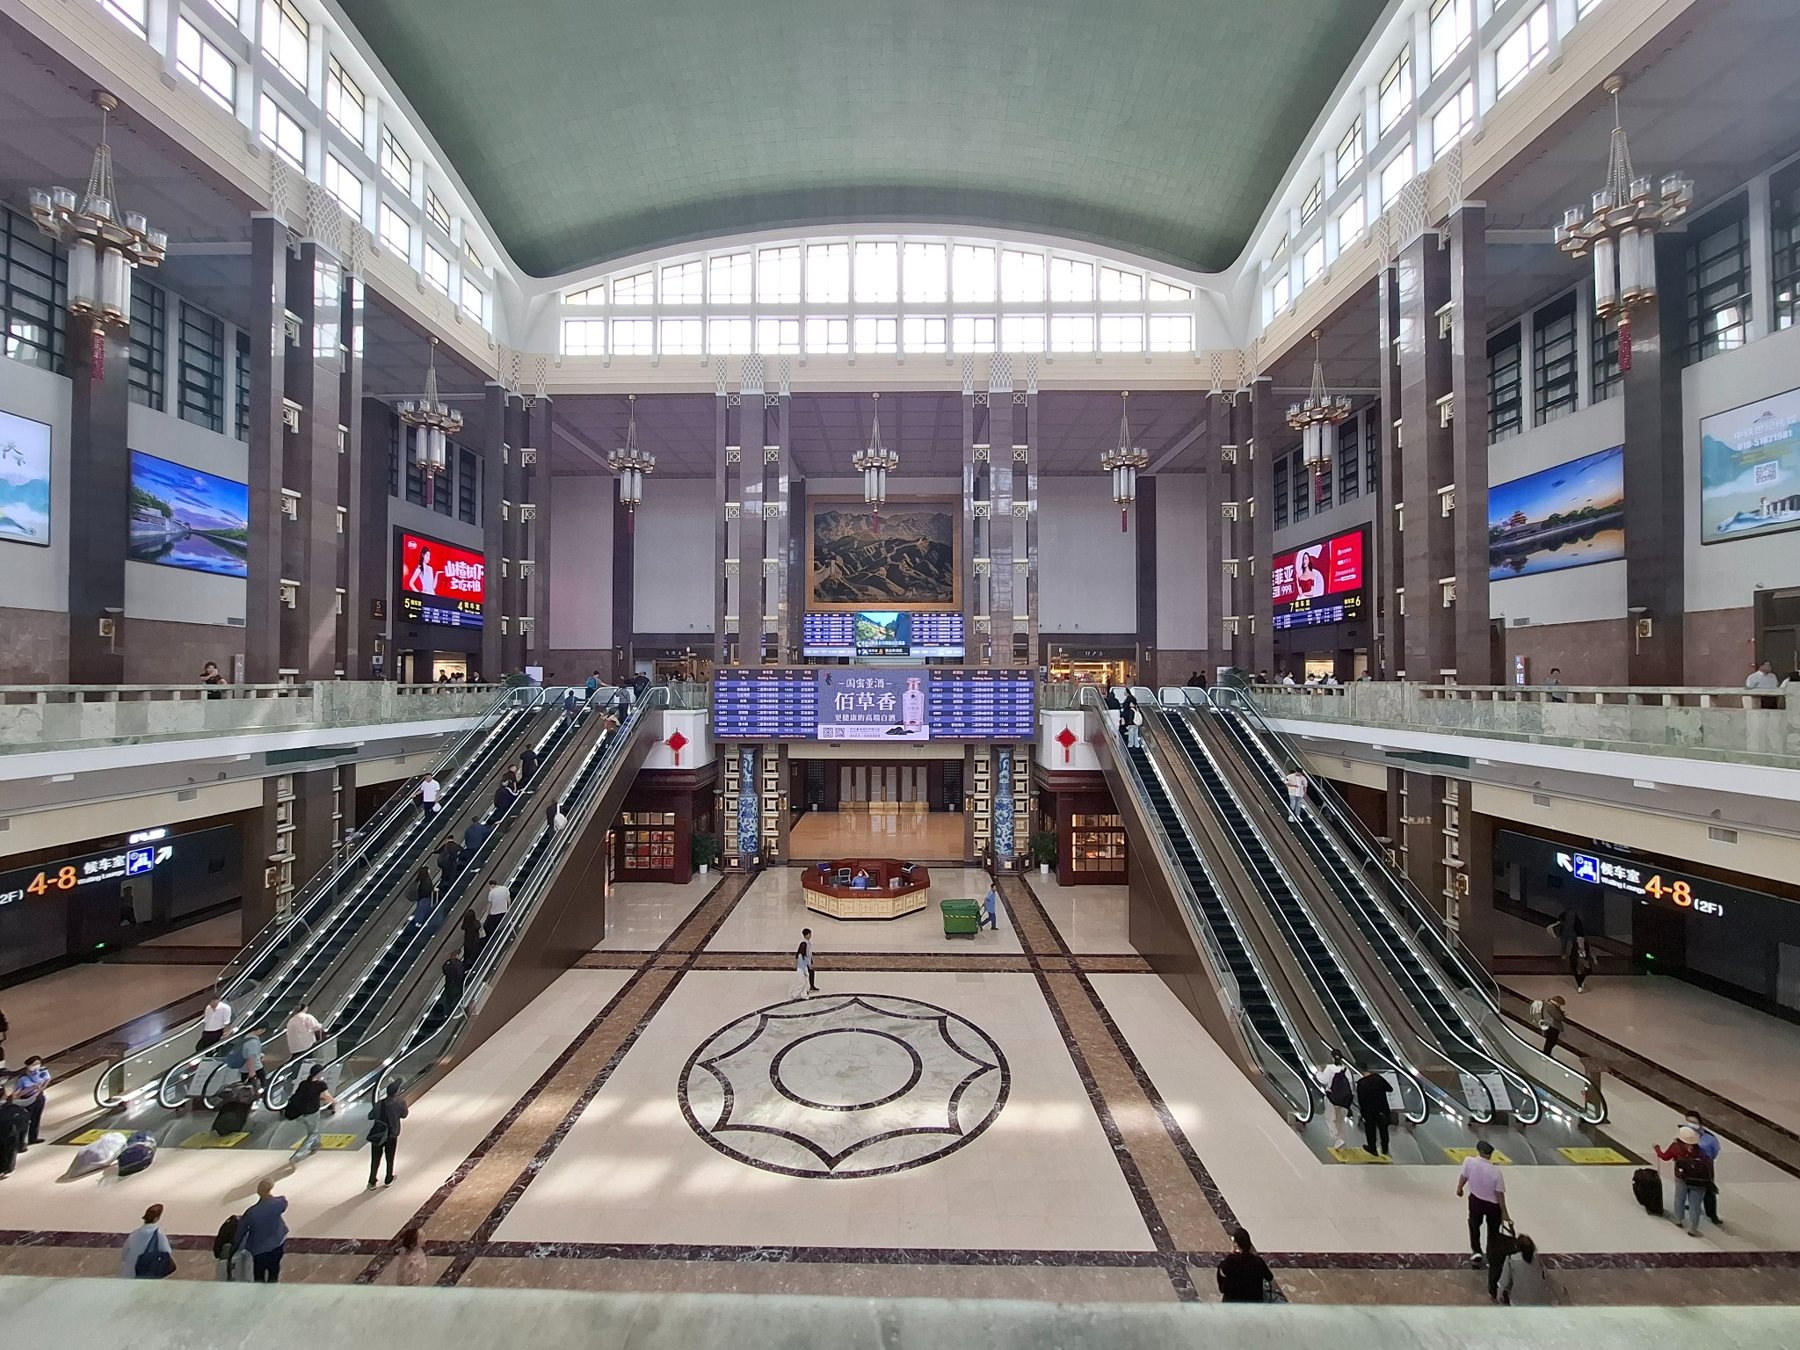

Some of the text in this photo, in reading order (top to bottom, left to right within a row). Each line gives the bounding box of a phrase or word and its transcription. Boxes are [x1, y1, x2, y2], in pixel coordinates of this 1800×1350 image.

[404, 598, 410, 609] 5
[457, 601, 463, 611] 4
[1289, 602, 1294, 613] 7
[1355, 596, 1361, 607] 6
[834, 692, 896, 711] 佰草香
[83, 855, 126, 875] 候车室
[1600, 861, 1641, 883] 候车室
[27, 866, 77, 895] 4-8
[1645, 874, 1723, 916] 4-8 (2F)
